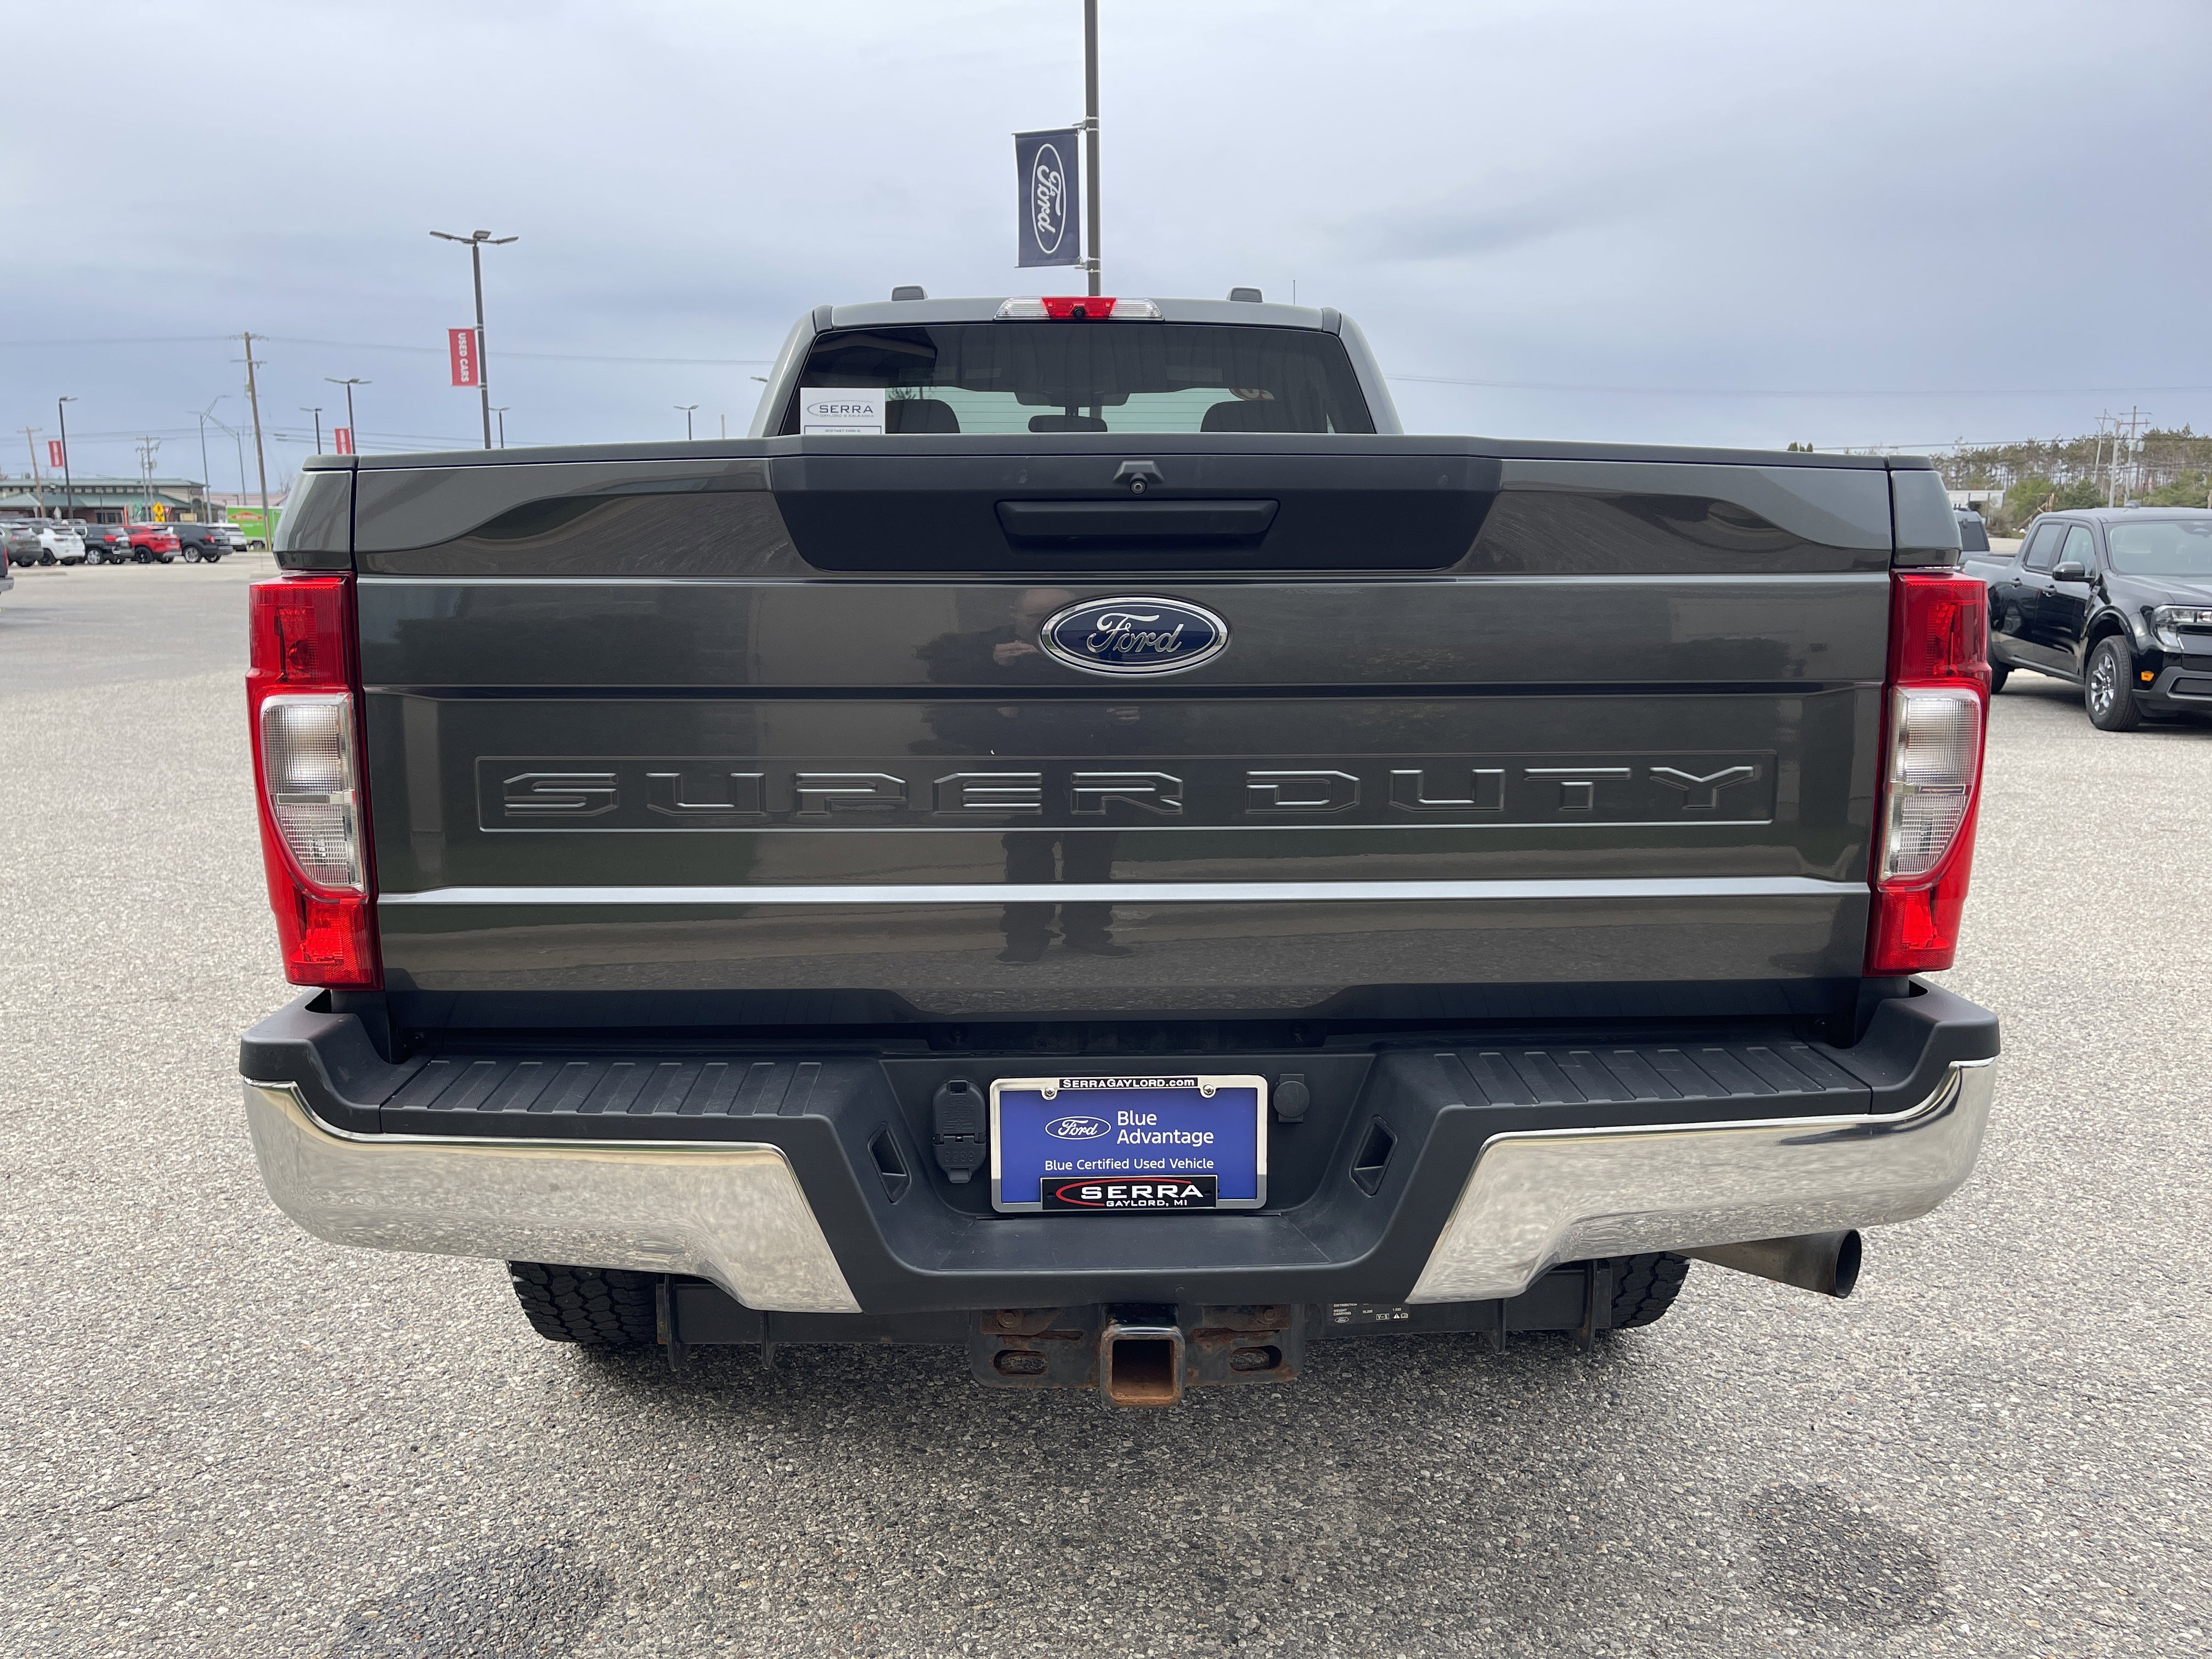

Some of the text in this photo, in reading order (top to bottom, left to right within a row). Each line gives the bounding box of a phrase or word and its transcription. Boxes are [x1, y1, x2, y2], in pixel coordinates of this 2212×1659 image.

[1036, 165, 1062, 233] Ford
[458, 332, 470, 383] USED CARS
[819, 405, 873, 413] SERRA
[1086, 612, 1184, 653] Ford
[503, 766, 1754, 817] SUPER DUTY
[1063, 1079, 1195, 1088] SERRAGAYLORD.com
[1117, 1110, 1157, 1126] Blue
[1058, 1119, 1098, 1136] Ford
[1116, 1128, 1214, 1147] Advantage
[1045, 1158, 1214, 1171] Blue Certified Used Vehicle
[1081, 1184, 1204, 1199] SERRA
[1106, 1199, 1169, 1207] GAYLORD,
